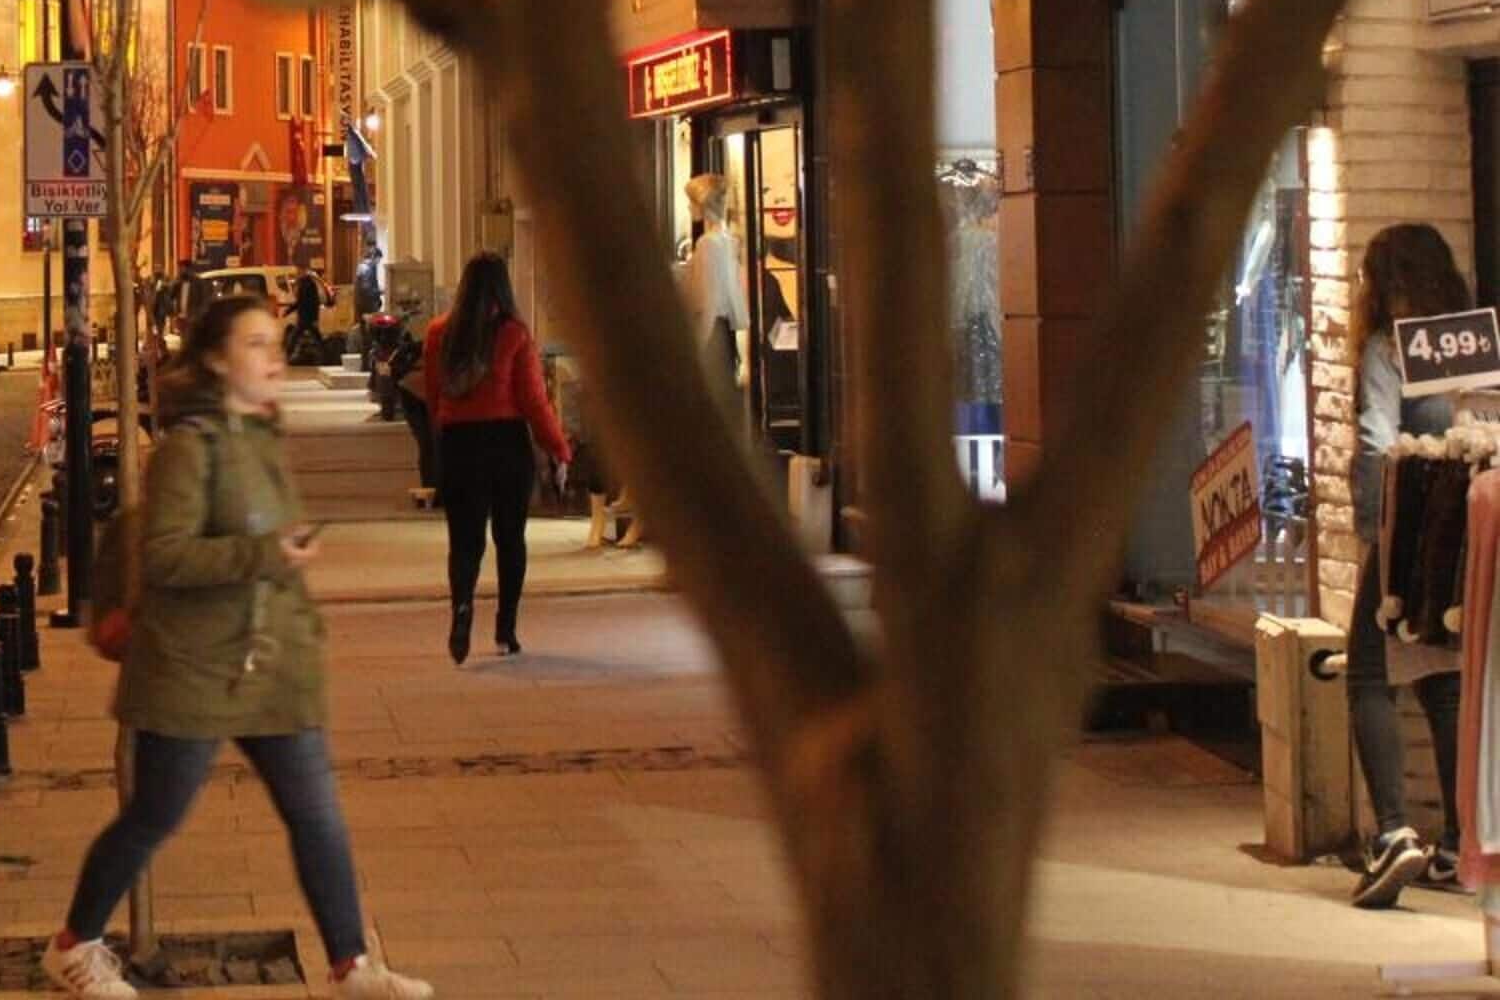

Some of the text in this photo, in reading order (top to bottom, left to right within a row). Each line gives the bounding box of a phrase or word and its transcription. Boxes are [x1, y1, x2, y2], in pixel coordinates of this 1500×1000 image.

[31, 183, 109, 200] Bisikletliy
[45, 200, 101, 213] Yol Ver
